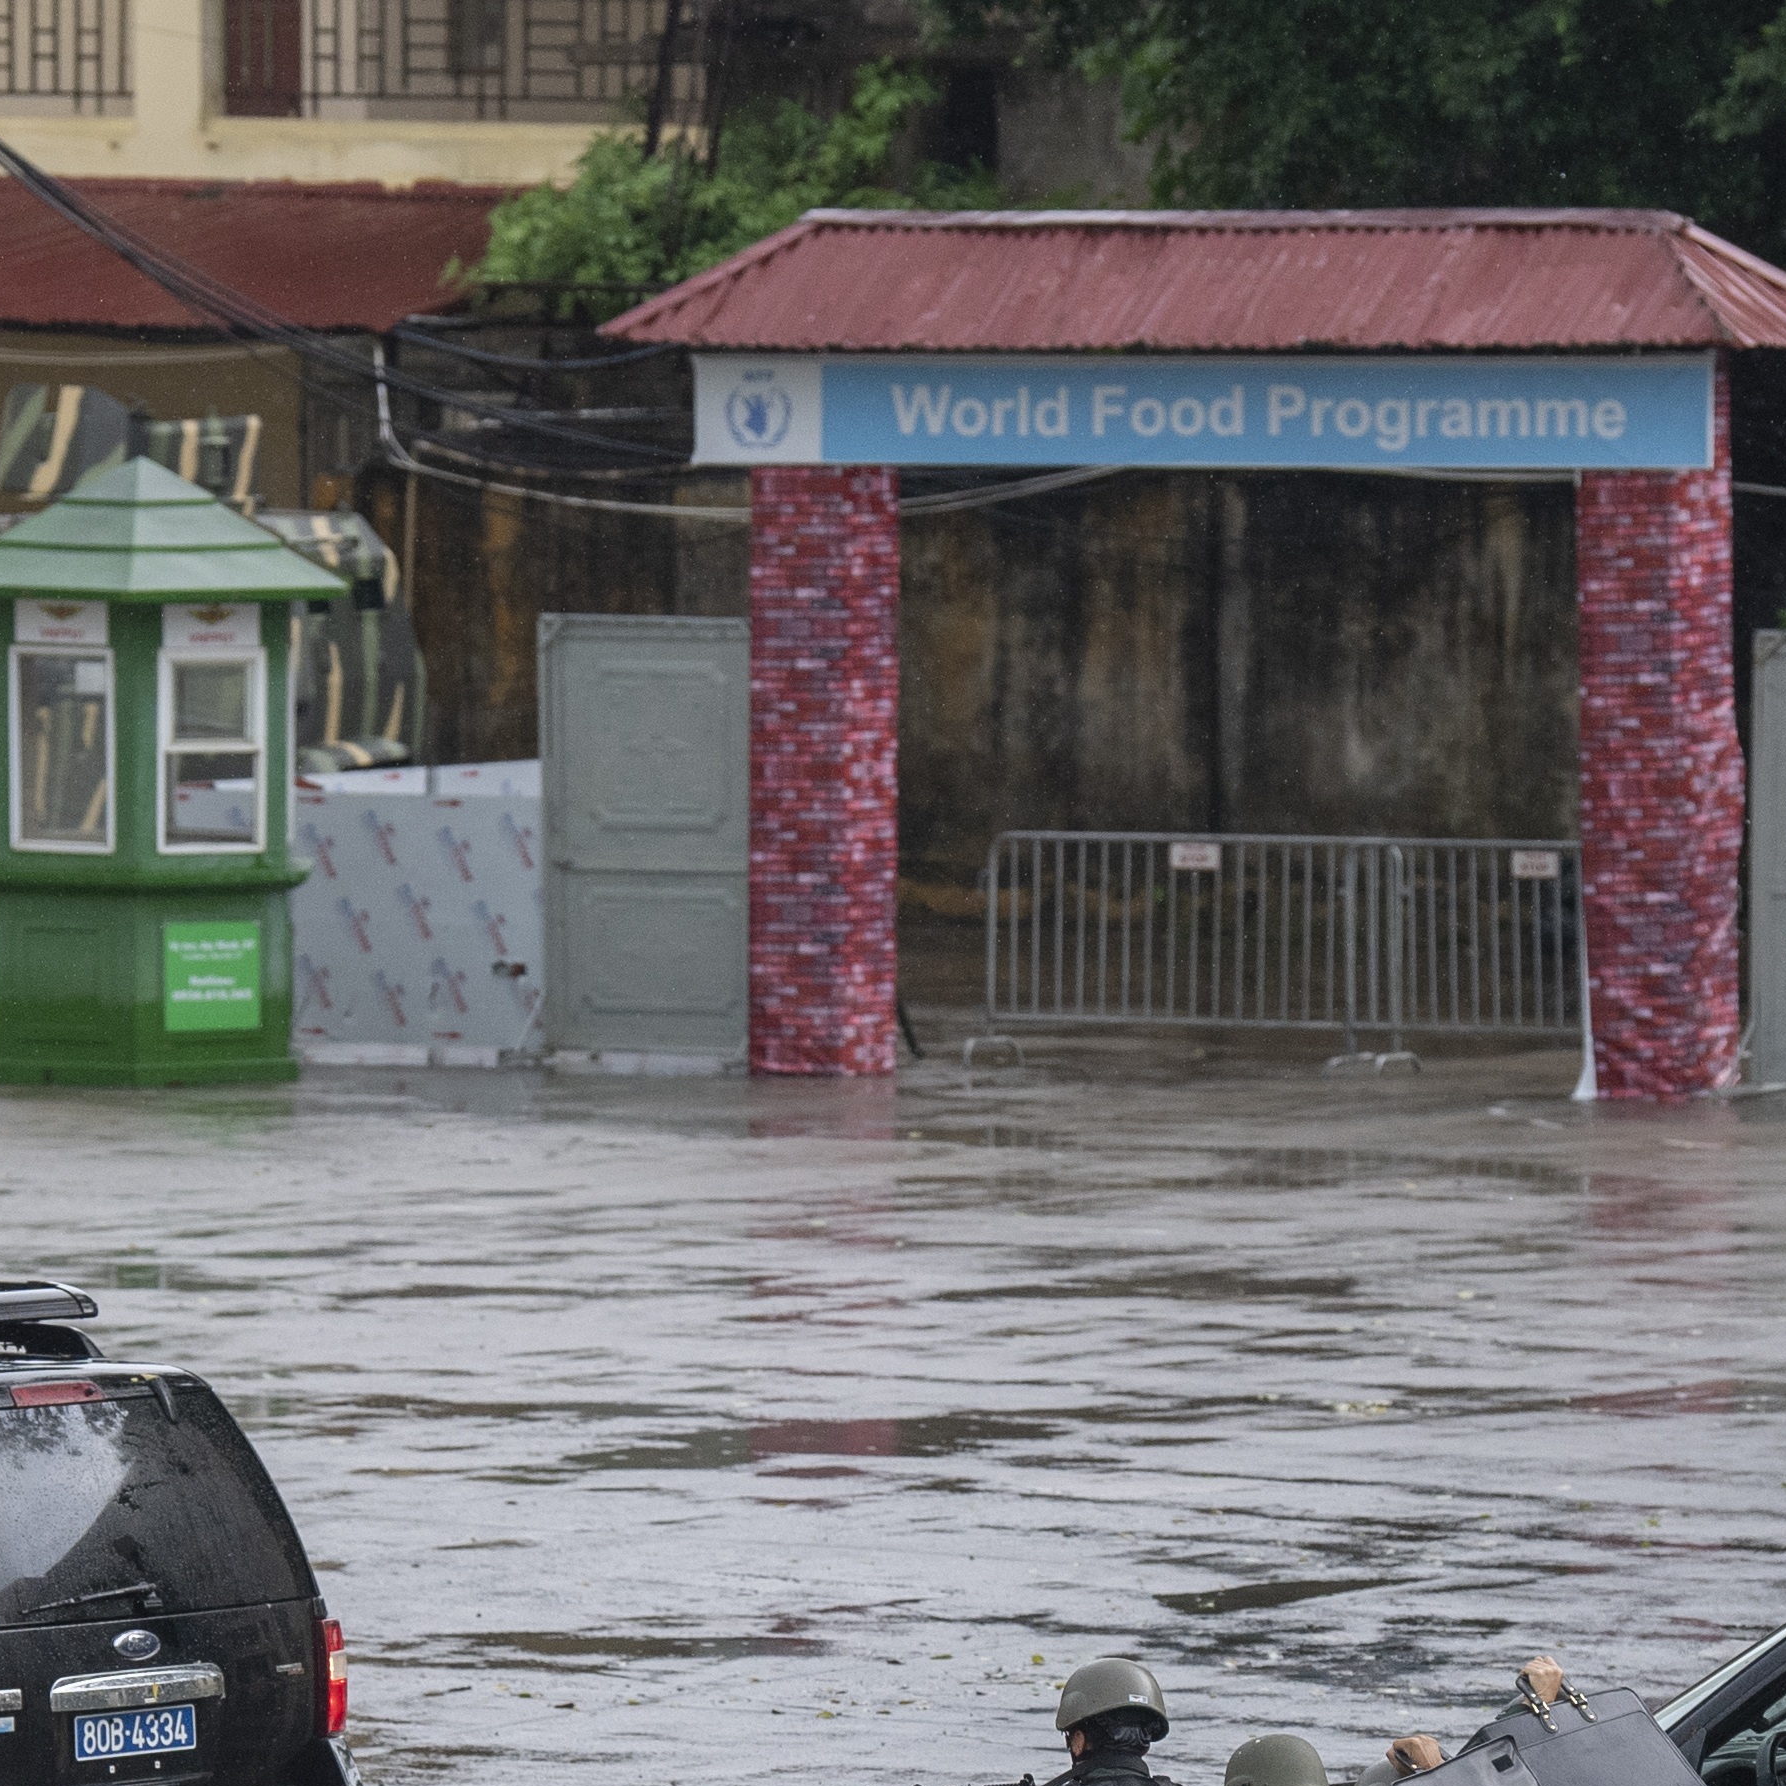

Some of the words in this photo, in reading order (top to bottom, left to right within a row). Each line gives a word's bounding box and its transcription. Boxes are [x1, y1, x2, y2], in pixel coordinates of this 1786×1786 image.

[891, 383, 1070, 438] World
[1092, 383, 1245, 437] Food
[1267, 384, 1628, 452] Programme
